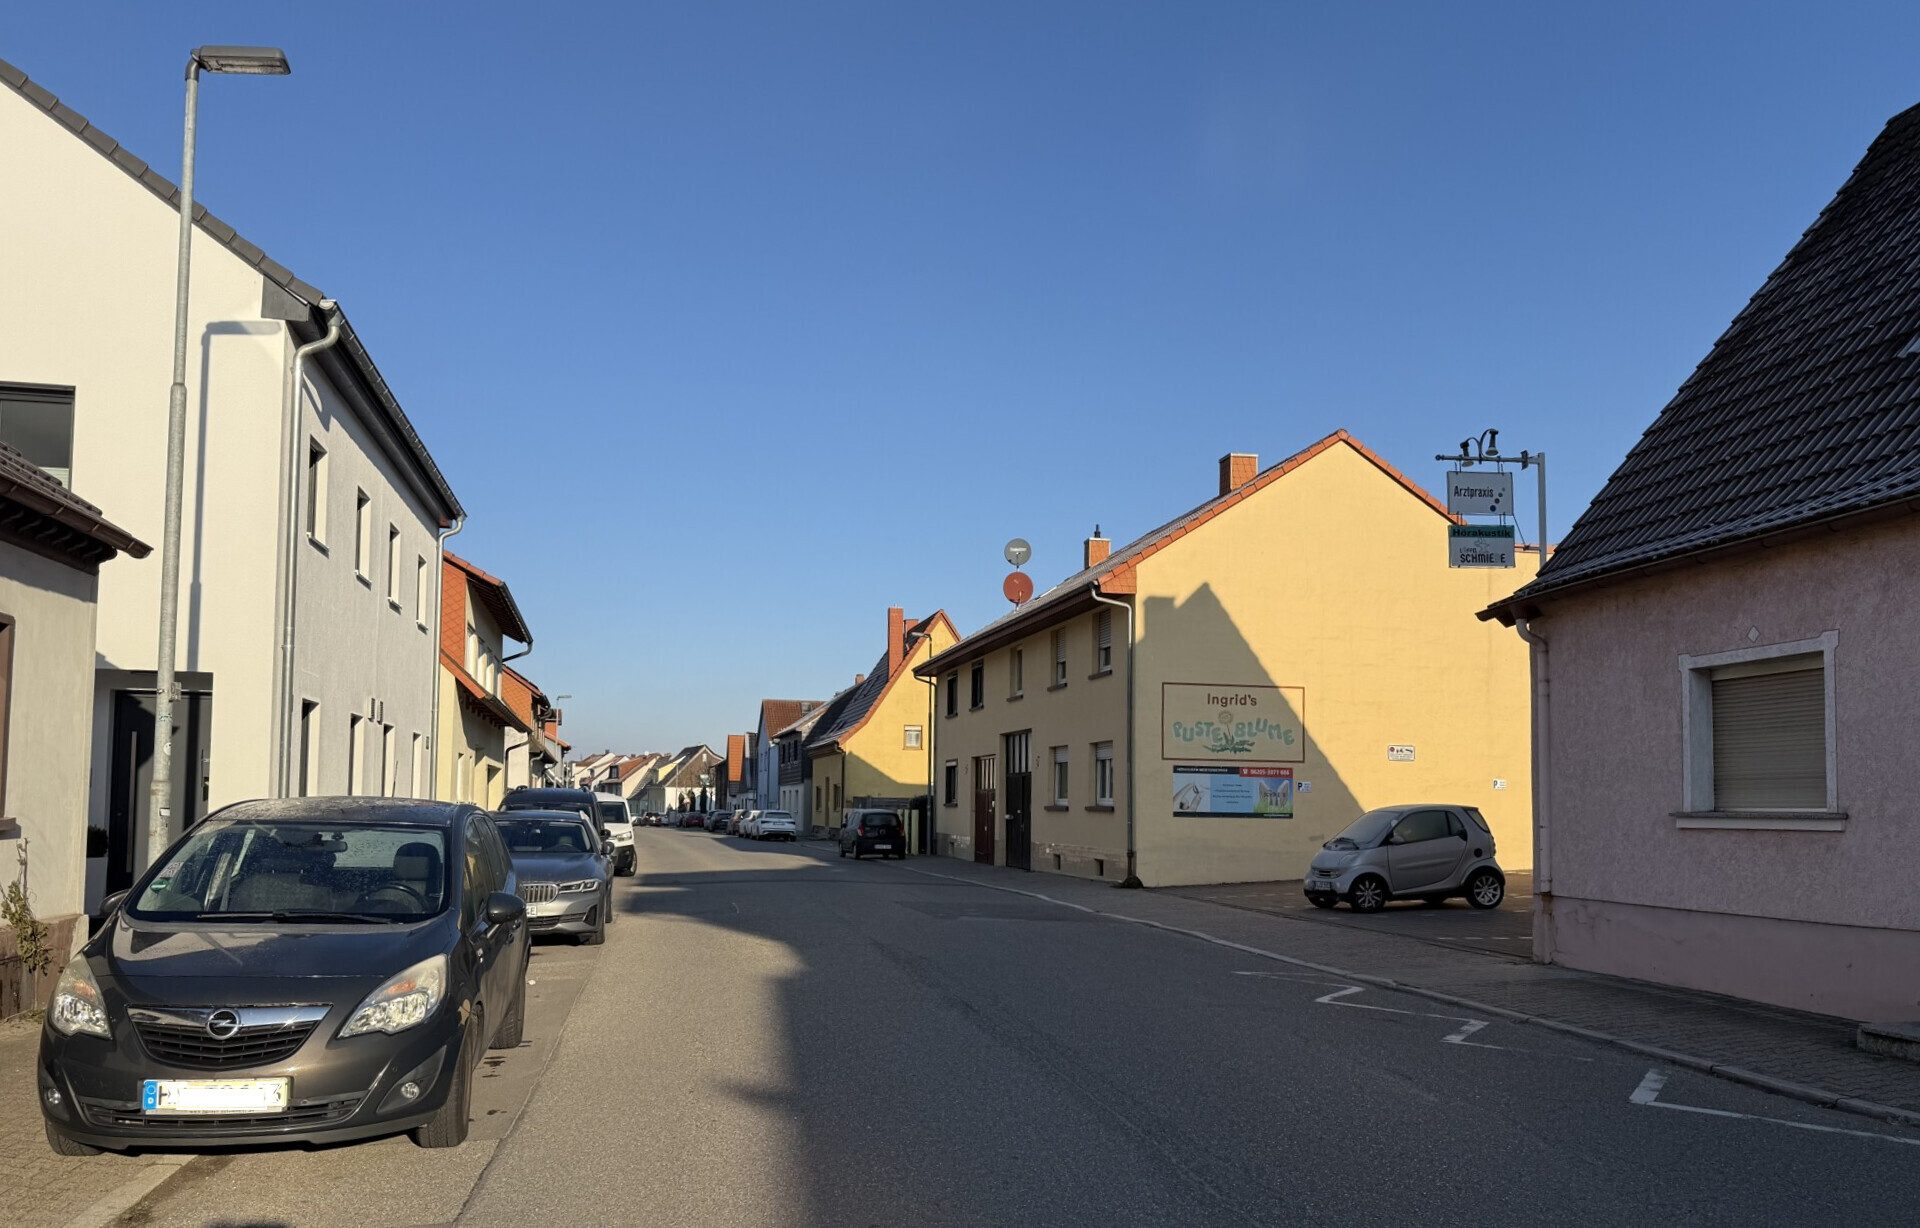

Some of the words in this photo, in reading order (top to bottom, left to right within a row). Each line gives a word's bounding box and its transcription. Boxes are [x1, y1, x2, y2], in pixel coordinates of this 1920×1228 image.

[1453, 486, 1494, 499] Arztpraxis
[1460, 553, 1506, 564] SCHMIEE
[1207, 693, 1258, 707] Ingrid's
